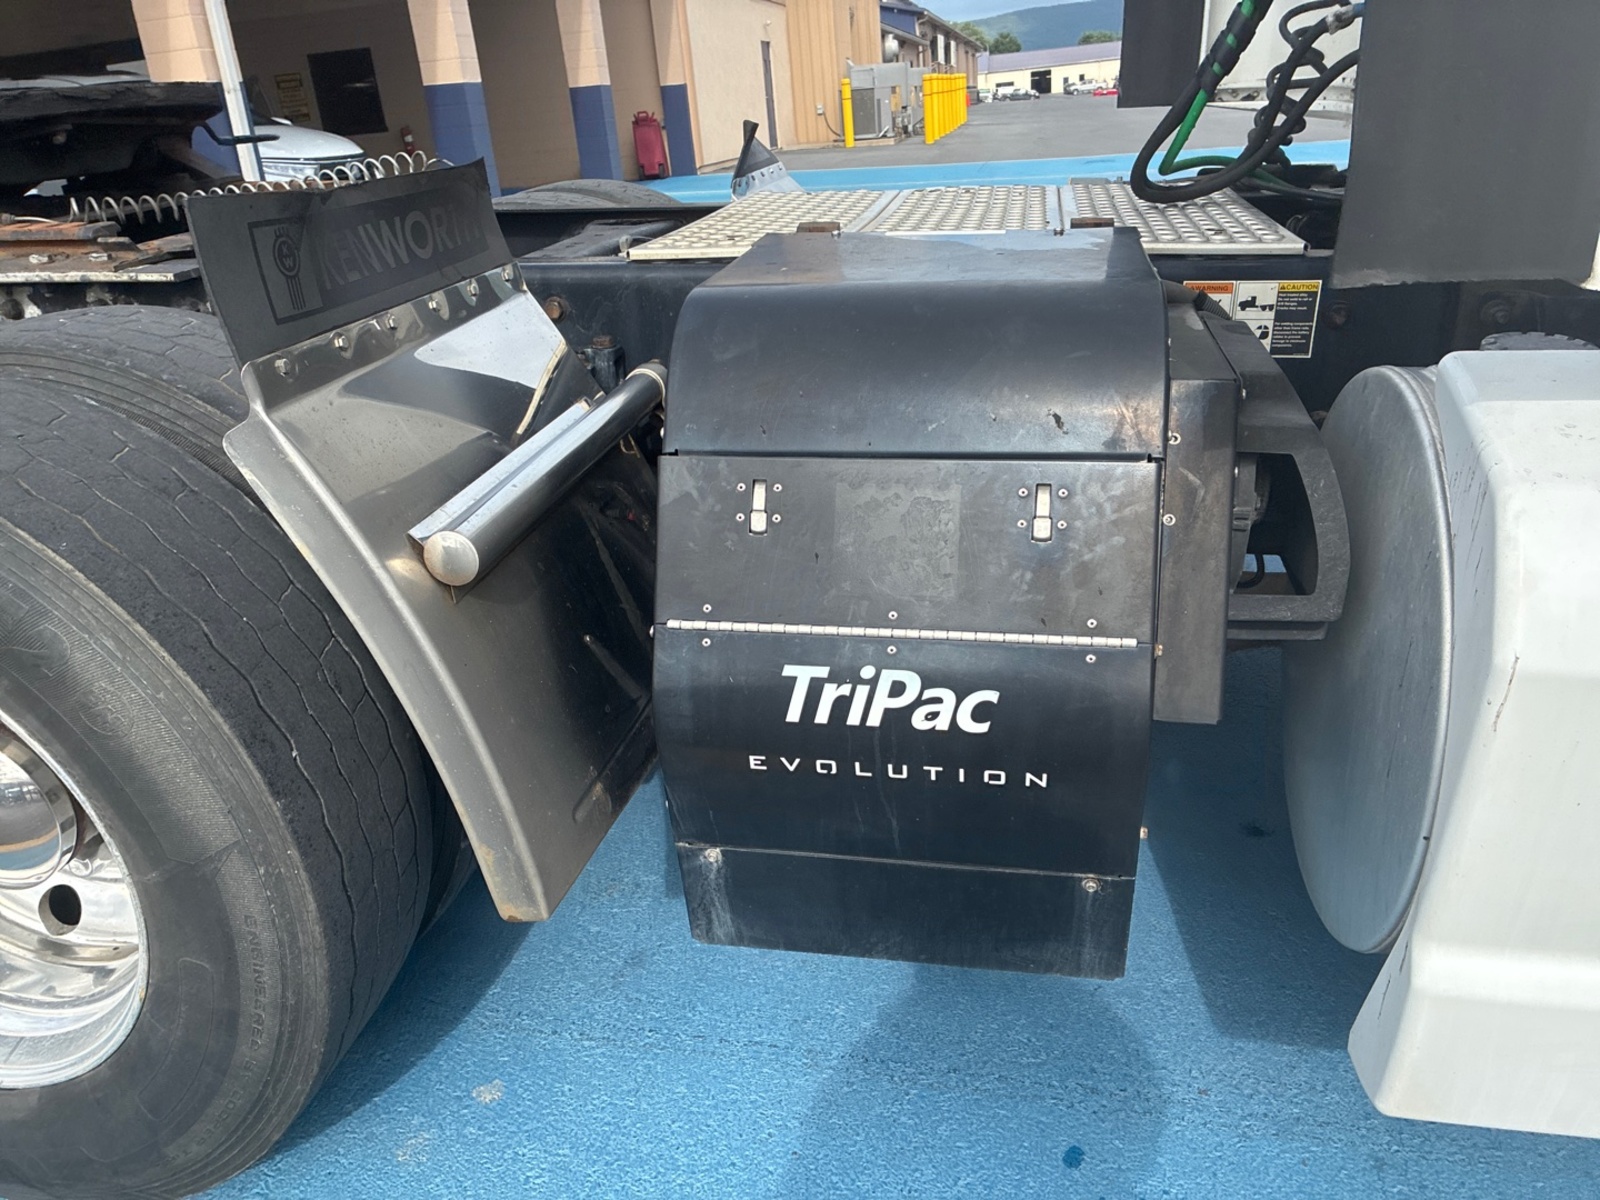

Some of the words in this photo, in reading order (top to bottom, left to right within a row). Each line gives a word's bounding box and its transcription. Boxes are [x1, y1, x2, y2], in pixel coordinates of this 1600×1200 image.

[316, 204, 481, 290] KENWORTH
[781, 664, 1000, 733] TriPac
[749, 755, 1048, 788] EVOLUTION
